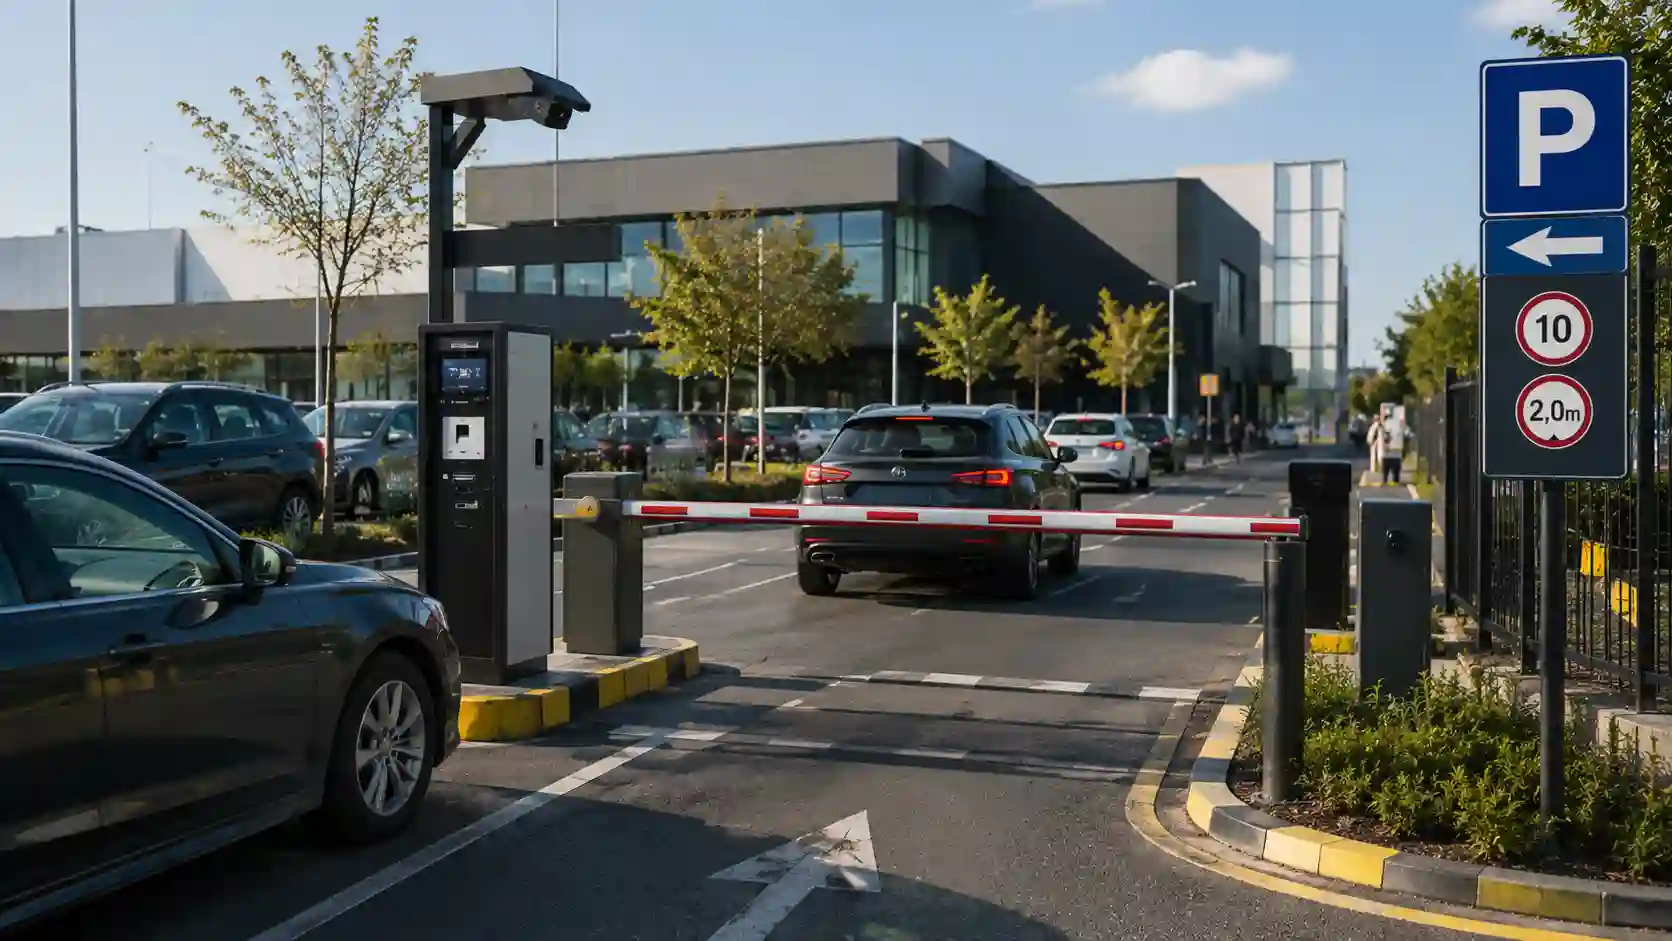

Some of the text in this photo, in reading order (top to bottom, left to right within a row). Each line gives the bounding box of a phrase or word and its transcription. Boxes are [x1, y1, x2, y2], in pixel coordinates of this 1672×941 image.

[1518, 90, 1596, 187] P
[1535, 314, 1572, 343] 10
[1529, 399, 1581, 425] 2,0m
